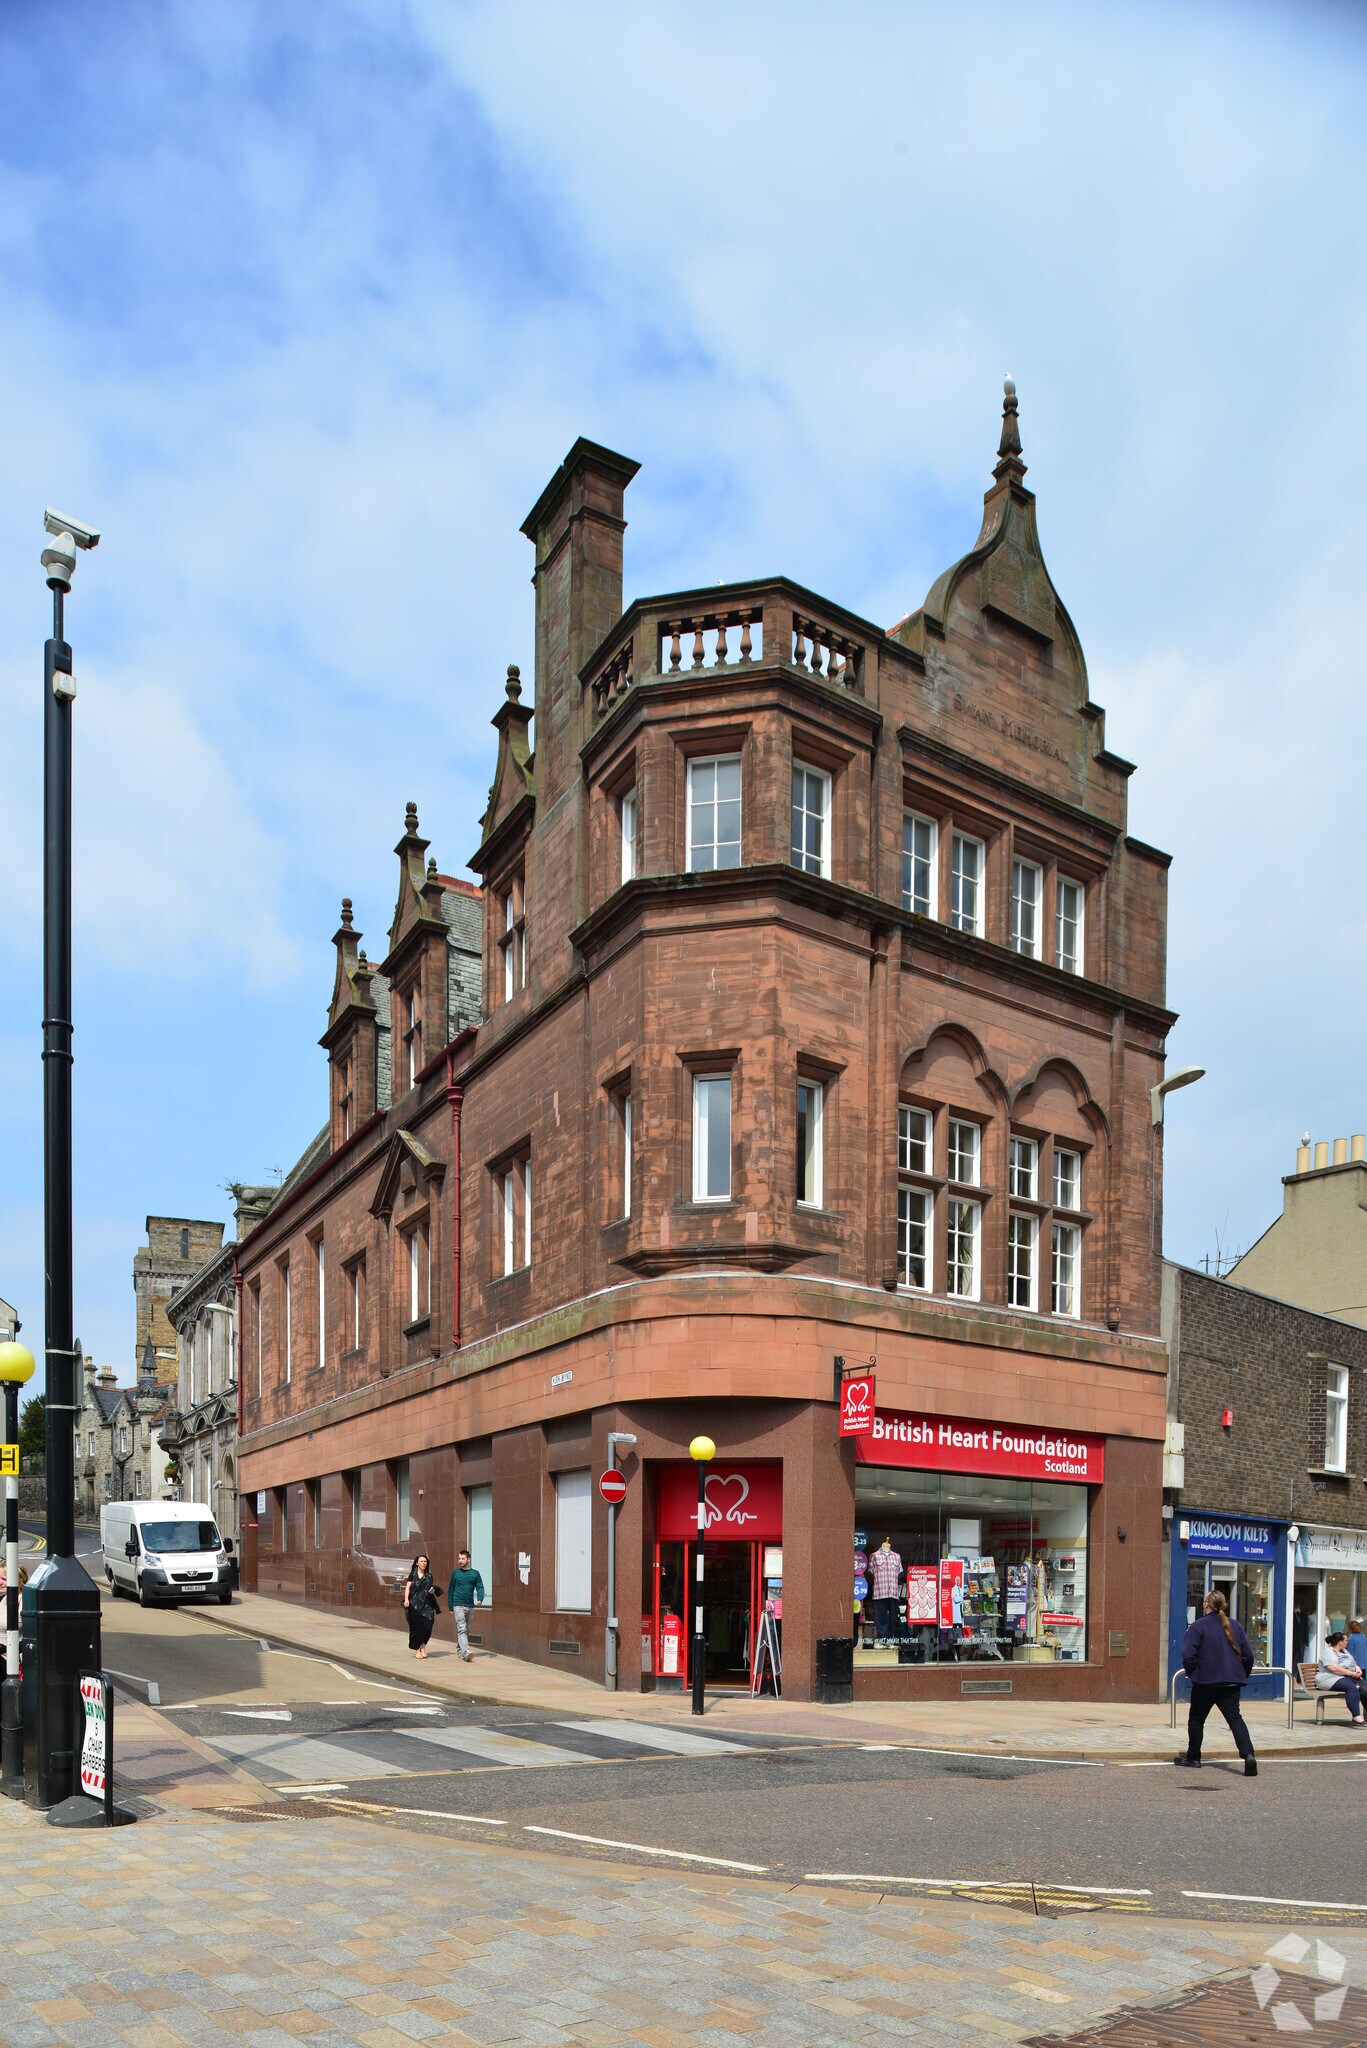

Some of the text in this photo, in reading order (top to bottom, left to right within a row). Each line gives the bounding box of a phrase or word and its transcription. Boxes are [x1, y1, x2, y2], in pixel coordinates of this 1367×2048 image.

[843, 1416, 857, 1424] British
[843, 1422, 870, 1431] Foundation
[872, 1416, 1088, 1459] British Heart Foundation
[1044, 1459, 1087, 1475] Scotland
[1189, 1520, 1269, 1543] KINGDOM KILTS
[1305, 1530, 1333, 1555] Special
[95, 1722, 99, 1736] 5
[87, 1737, 102, 1755] CHAIR
[82, 1751, 105, 1774] BARBERS
